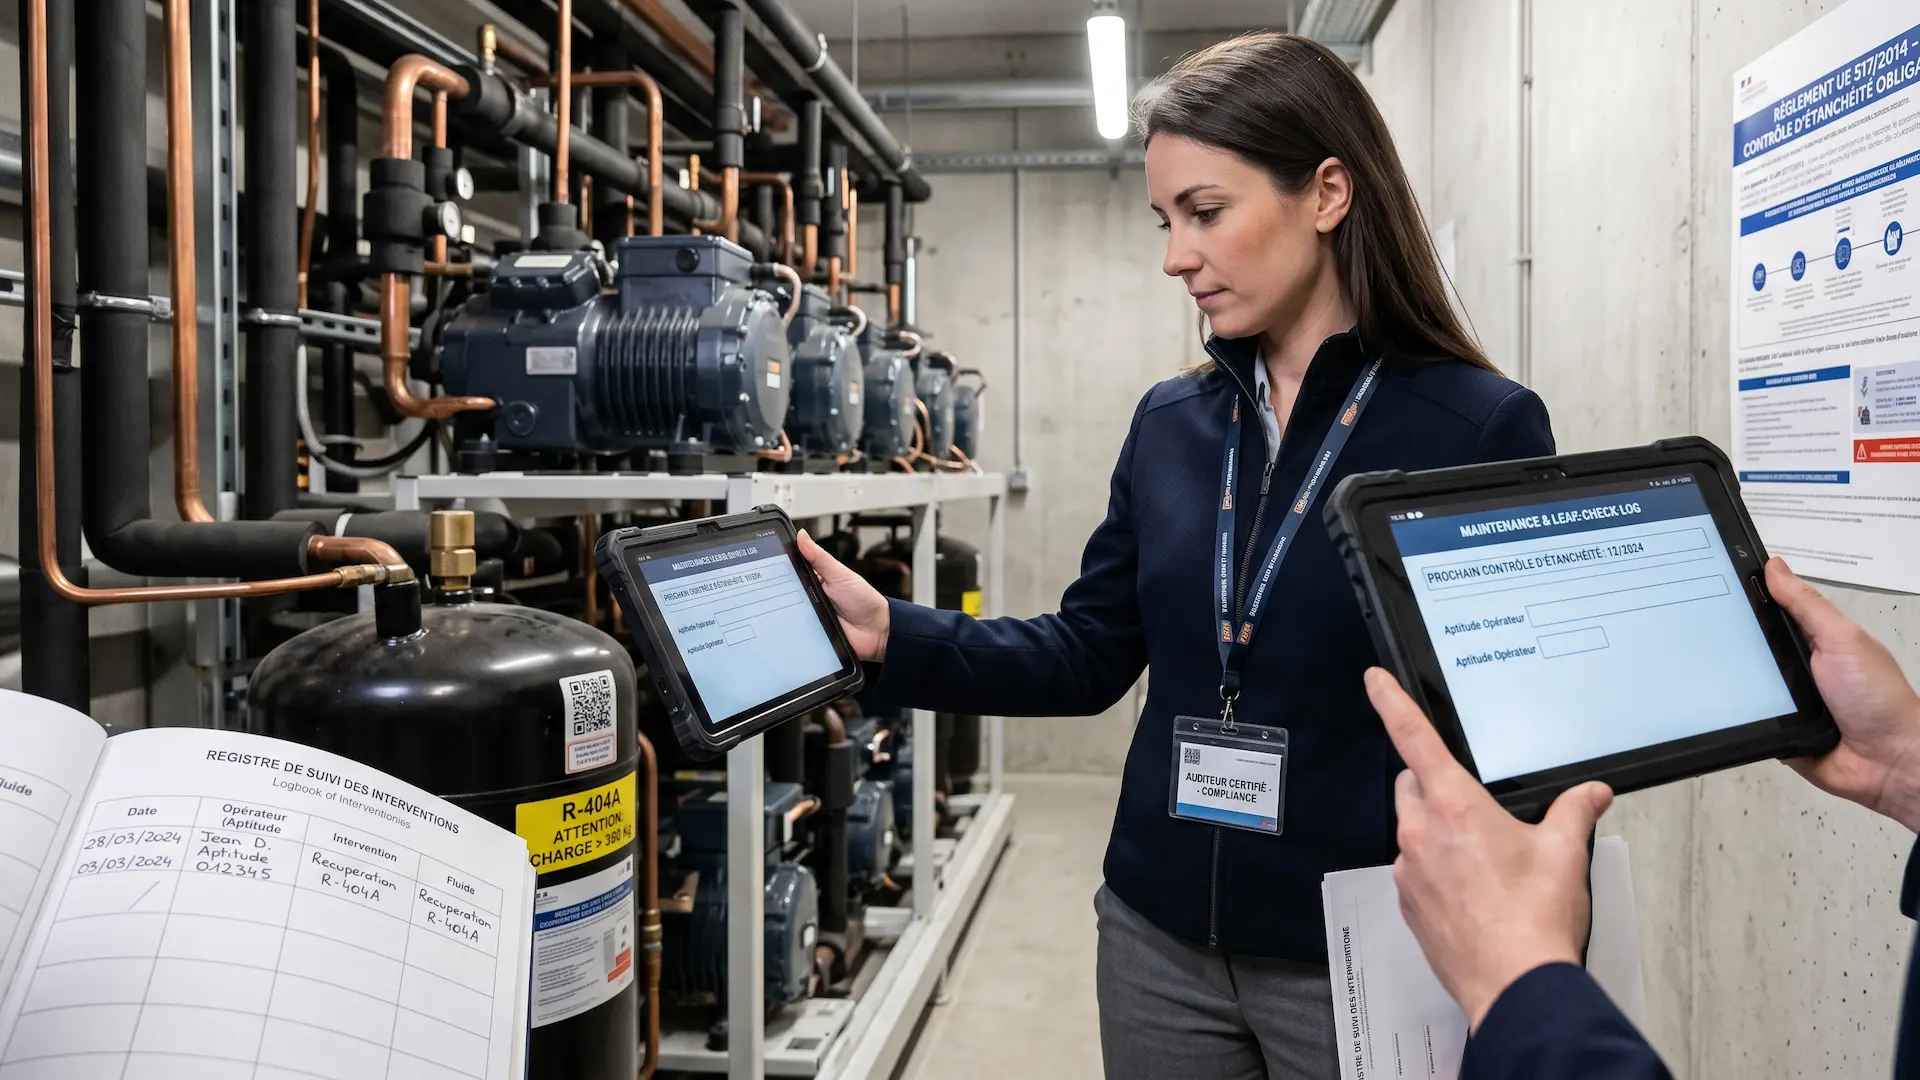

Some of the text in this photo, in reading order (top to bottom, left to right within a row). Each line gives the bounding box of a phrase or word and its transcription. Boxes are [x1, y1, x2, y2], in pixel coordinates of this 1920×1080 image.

[1773, 77, 1835, 123] RÈGLEMENT
[1836, 68, 1852, 91] UE
[1854, 38, 1909, 82] 517/2014
[1743, 122, 1793, 158] CONTRÔLE
[1459, 515, 1541, 538] MAINTENANCE
[1542, 514, 1551, 527] &
[1427, 566, 1481, 583] PROCHAIN
[1482, 557, 1538, 576] CONTRÔLE
[1607, 542, 1644, 557] 12/2024
[1444, 614, 1525, 636] Aptitude Opérateur
[1455, 646, 1536, 668] Aptitude Opérateur
[0, 777, 33, 796] luide
[206, 750, 460, 834] REGISTRE DE SUIVI DES INTERVENTIONS
[272, 777, 322, 798] Logbook
[325, 791, 338, 800] of
[1185, 772, 1227, 787] AUDITEUR
[1228, 778, 1267, 793] CERTIFIÉ
[562, 788, 621, 822] R-404A
[1201, 786, 1257, 804] COMPLIANCE
[127, 806, 158, 817] Date
[222, 803, 288, 822] Opérateur
[222, 817, 282, 834] (Aptitude
[553, 811, 624, 844] ATTENTION:
[84, 830, 182, 850] 28/03/2024
[200, 830, 272, 850] Jean D.
[333, 832, 397, 862] Intervention
[197, 846, 269, 865] Aptitude
[530, 840, 593, 867] CHARGE
[77, 855, 172, 875] 03/03/2024
[196, 861, 272, 880] 012345
[312, 851, 397, 890] Recuperation
[446, 875, 475, 895] Fluide
[419, 888, 492, 929] Recuperation
